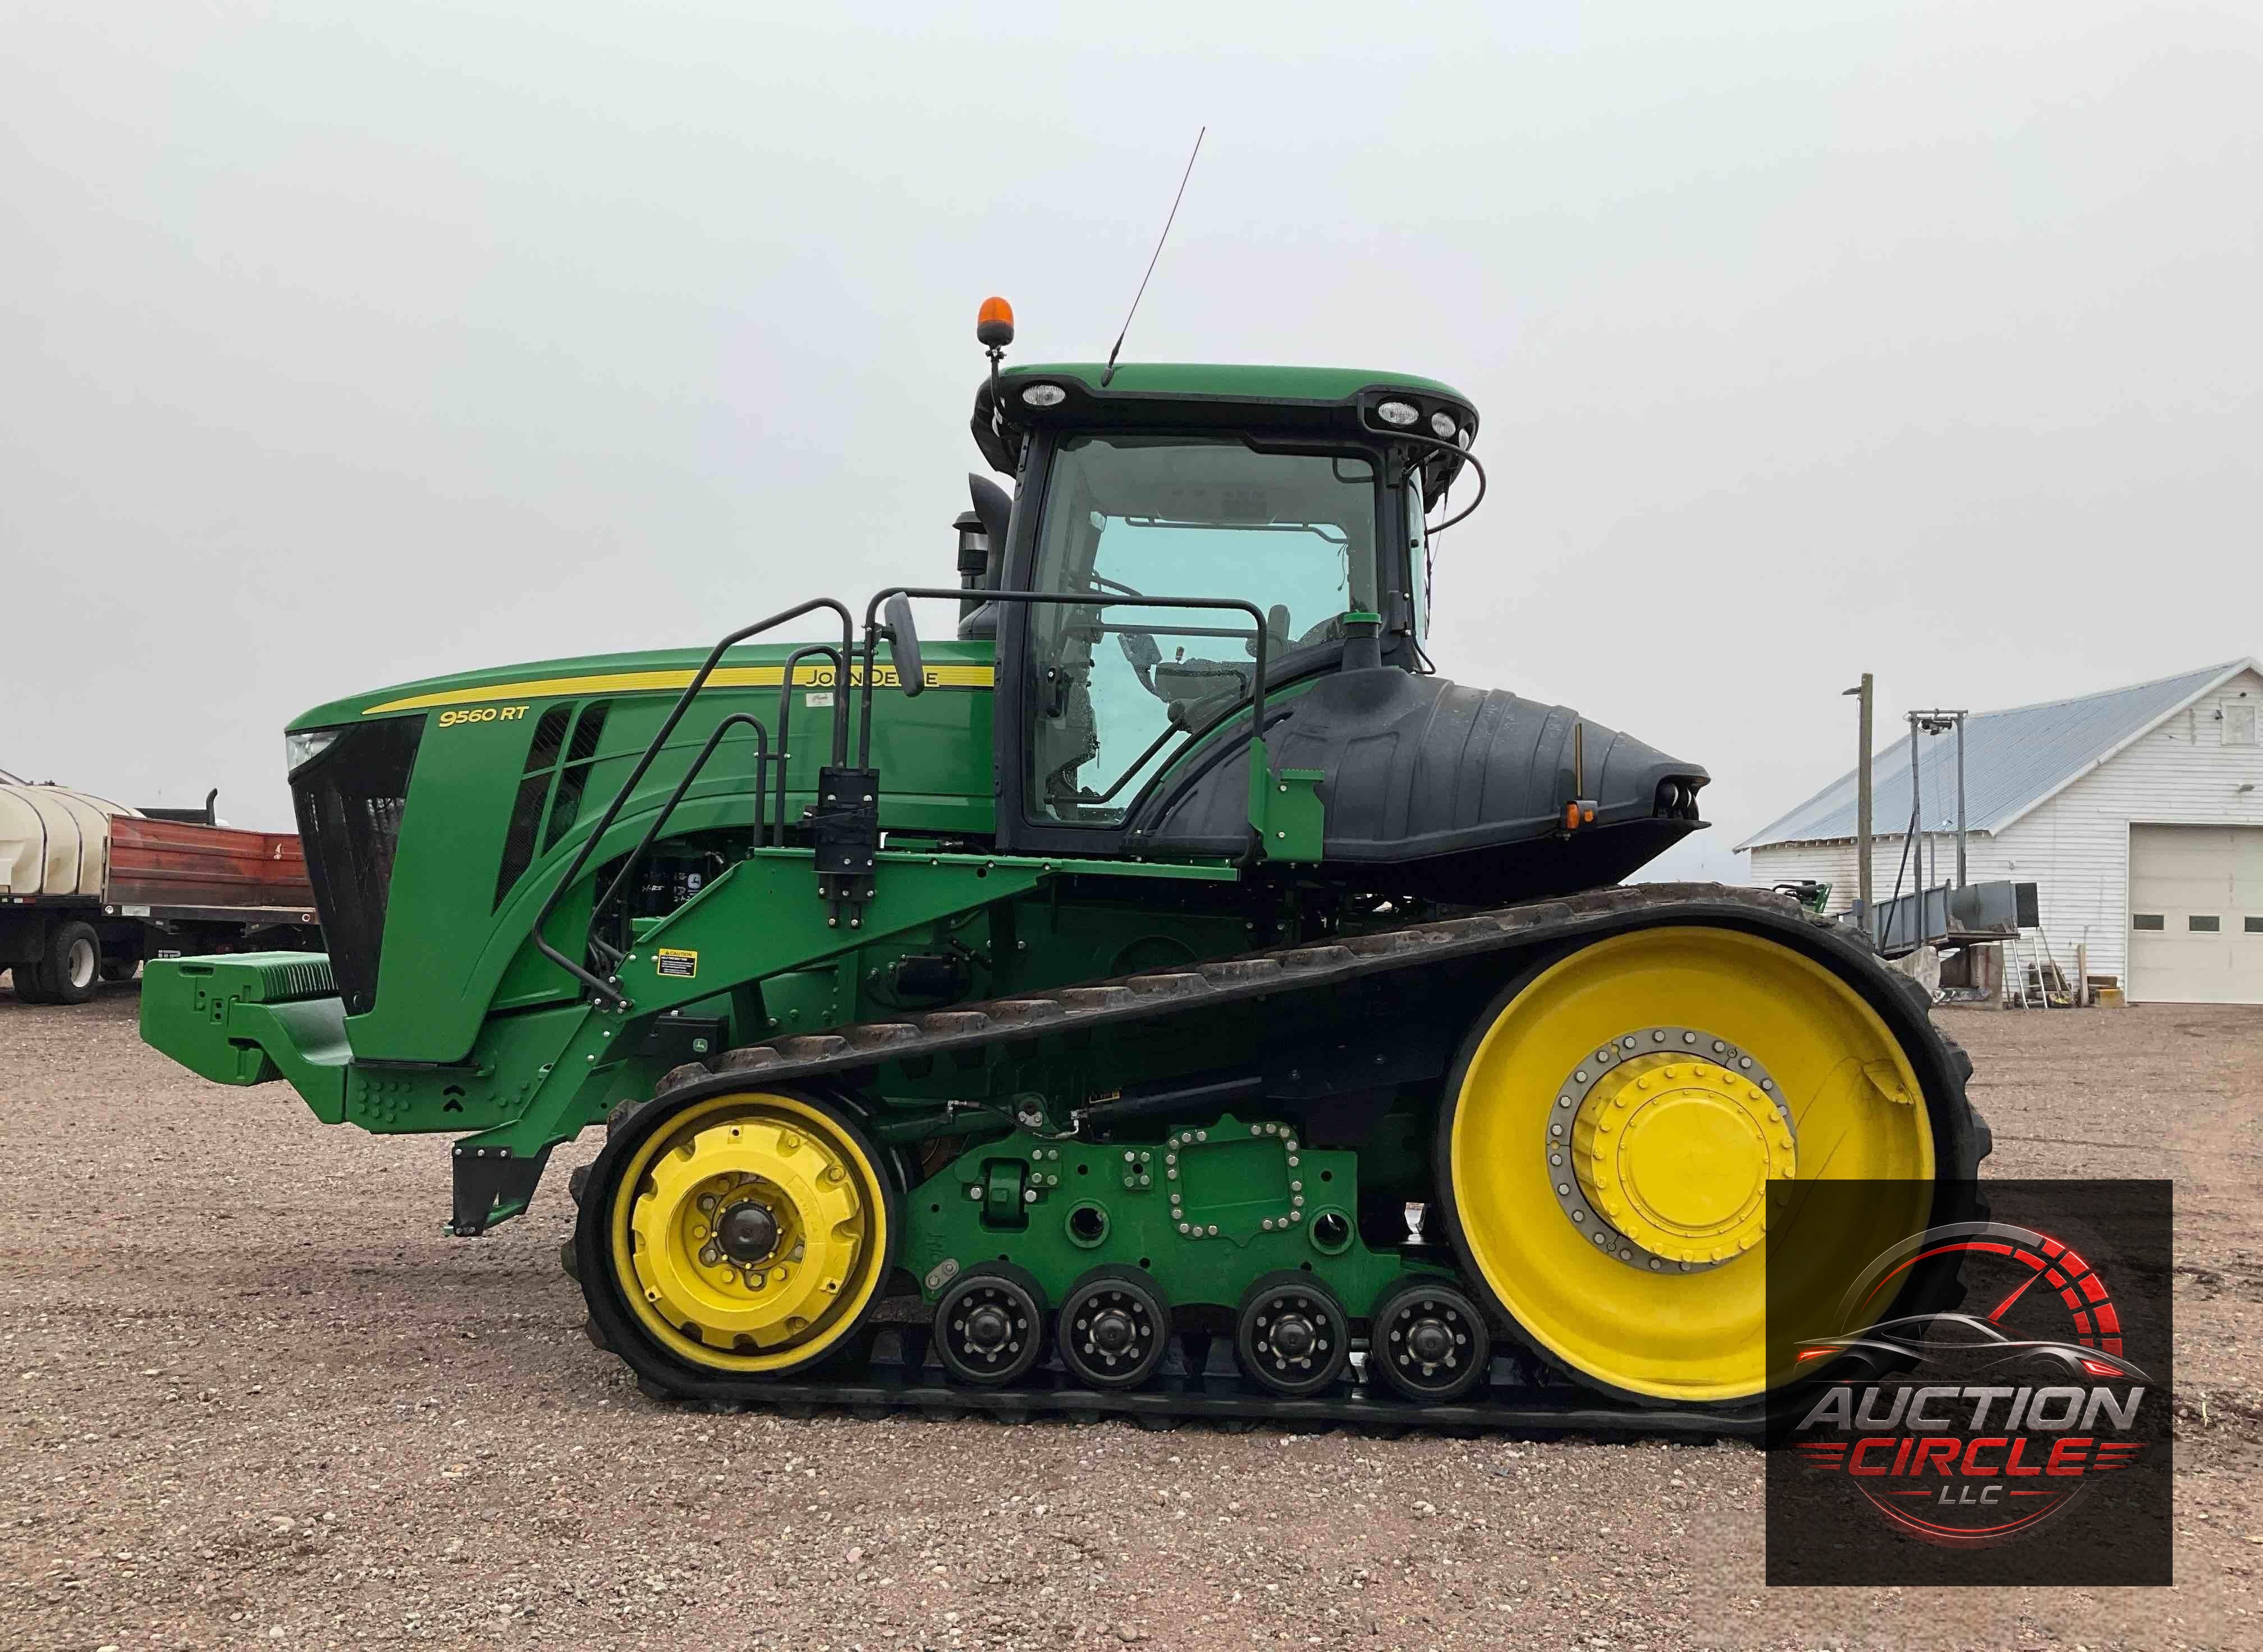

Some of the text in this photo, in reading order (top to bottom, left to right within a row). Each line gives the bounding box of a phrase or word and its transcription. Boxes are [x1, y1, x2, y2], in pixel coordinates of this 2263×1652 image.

[805, 669, 938, 685] JON DEE
[438, 705, 530, 728] 9560 RT
